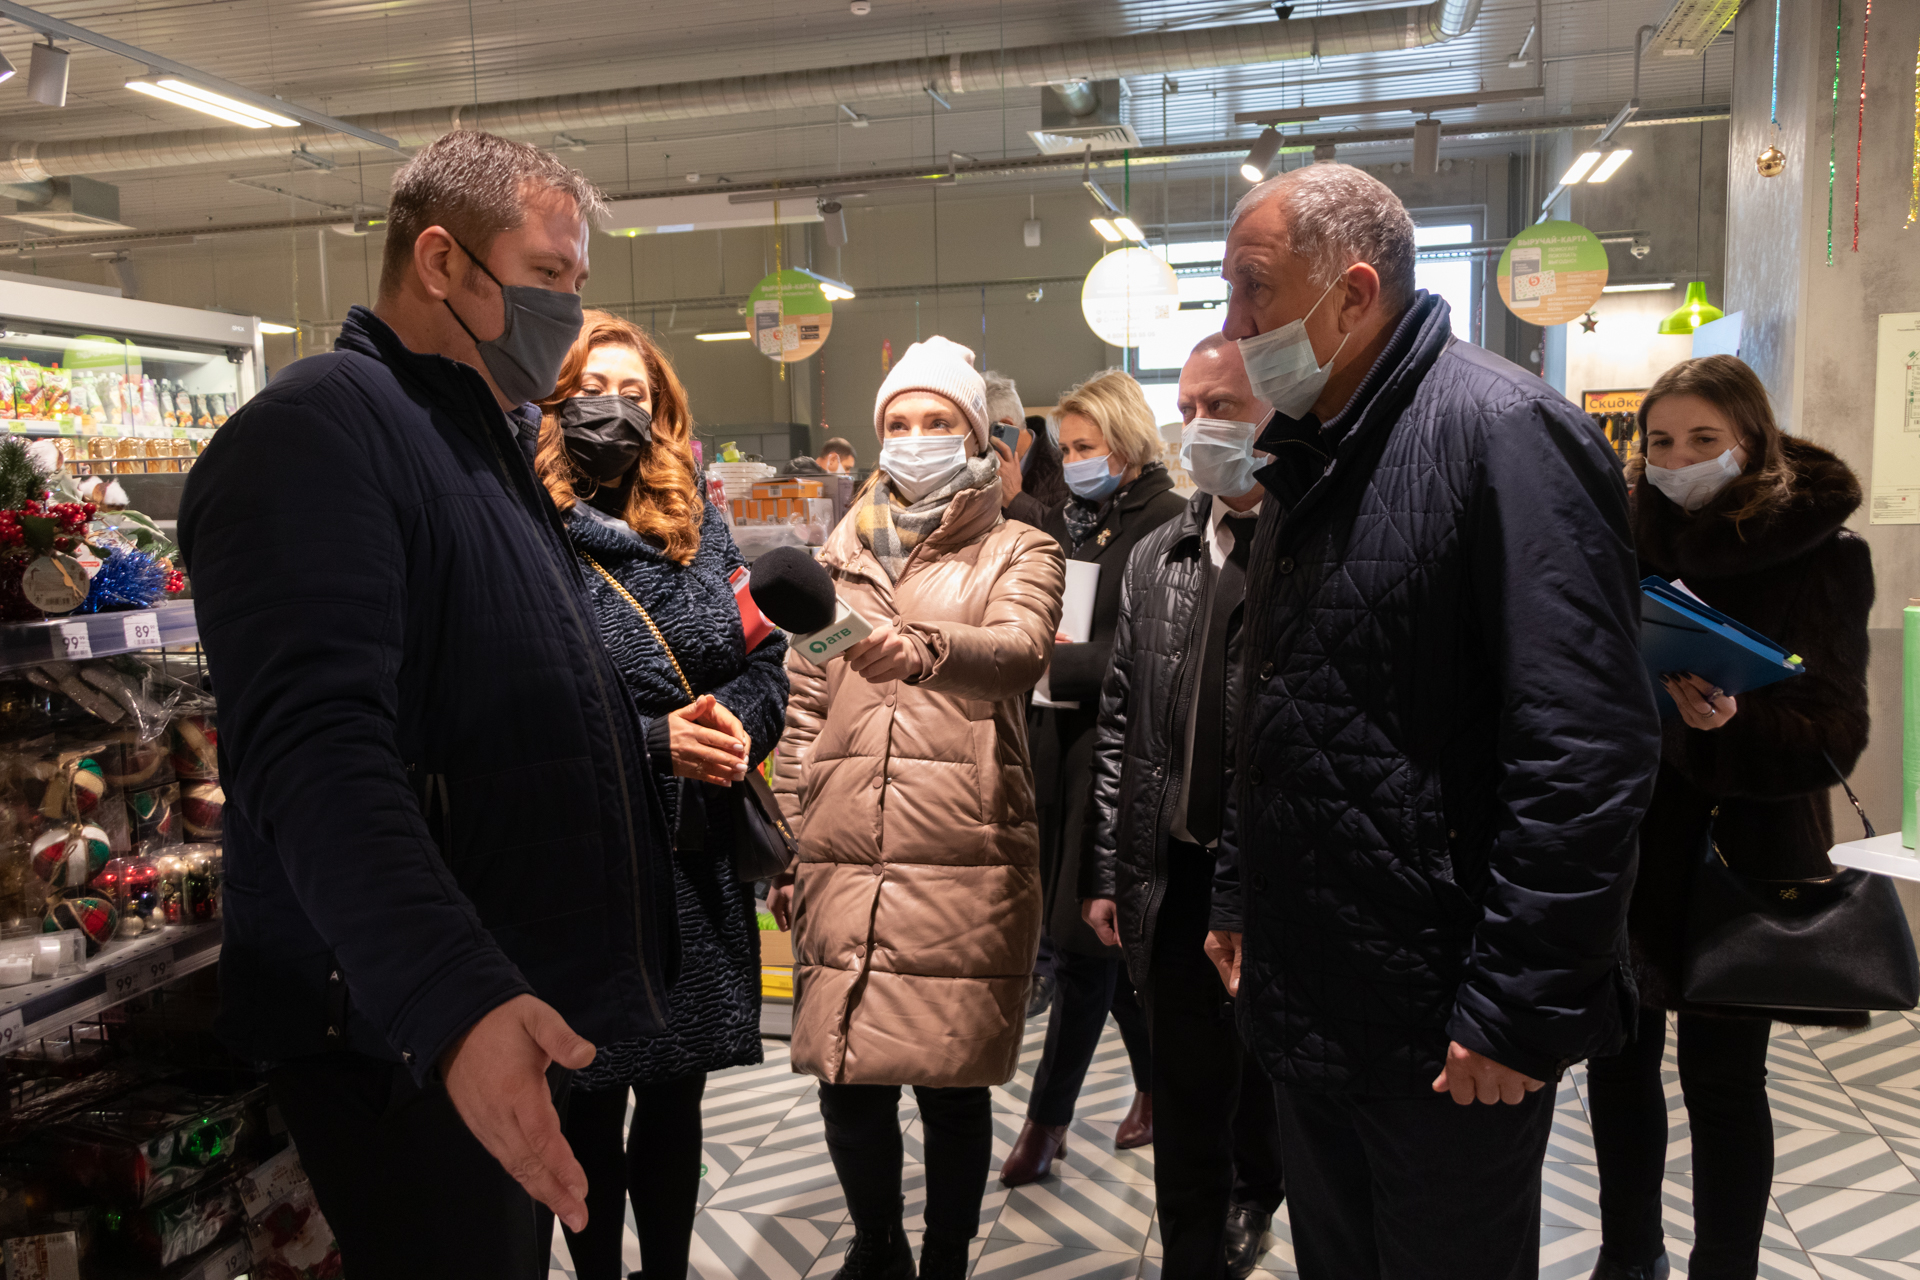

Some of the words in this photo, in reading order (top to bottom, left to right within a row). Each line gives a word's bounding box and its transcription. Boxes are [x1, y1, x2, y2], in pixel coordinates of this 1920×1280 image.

[1517, 235, 1588, 246] ВЫРУЧАЙ-КАРТА
[761, 283, 815, 292] ВЫРУАЙ-КАРТА
[134, 625, 150, 638] 89
[62, 636, 79, 650] 99
[151, 962, 166, 977] 99
[116, 975, 132, 992] 99
[225, 1255, 237, 1272] 19
